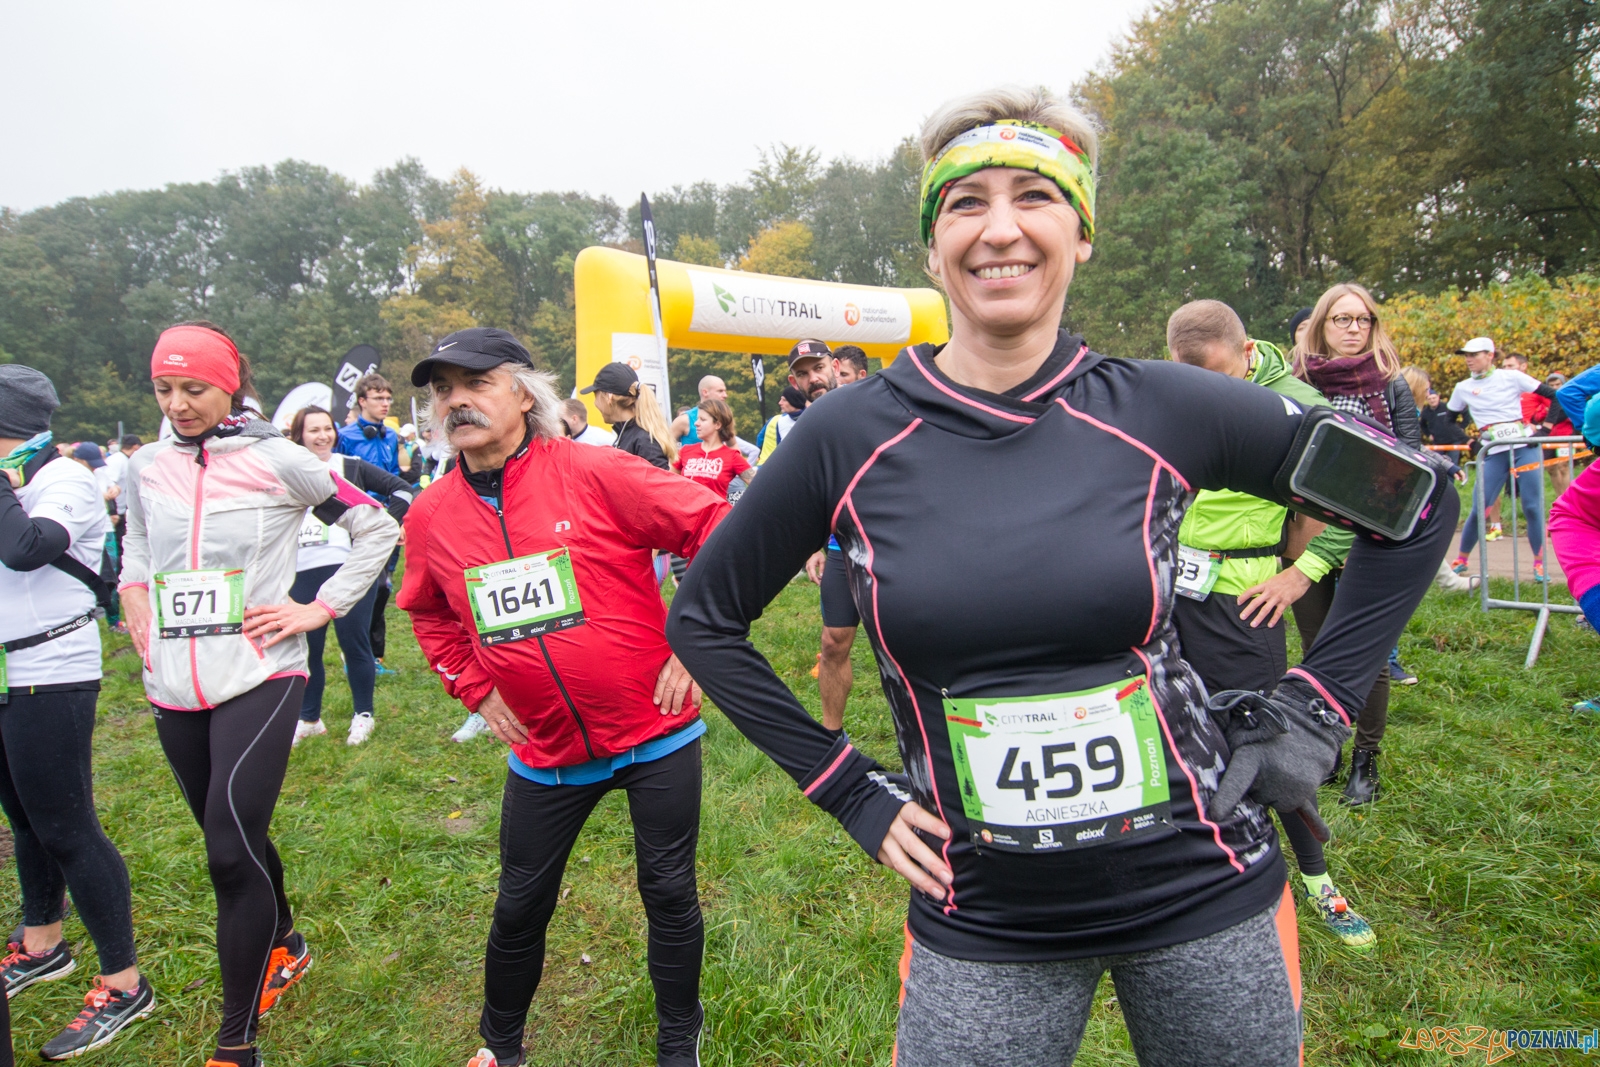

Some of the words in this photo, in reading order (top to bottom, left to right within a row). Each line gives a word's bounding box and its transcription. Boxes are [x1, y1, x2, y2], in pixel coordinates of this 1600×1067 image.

[172, 590, 216, 616] 671
[488, 578, 554, 617] 1641
[564, 579, 577, 605] Poznań
[175, 616, 213, 625] MAGDALENA
[996, 735, 1125, 801] 459
[1144, 737, 1162, 787] Poznań
[1025, 800, 1109, 822] AGNIESZKA
[1133, 812, 1155, 823] POLSKA
